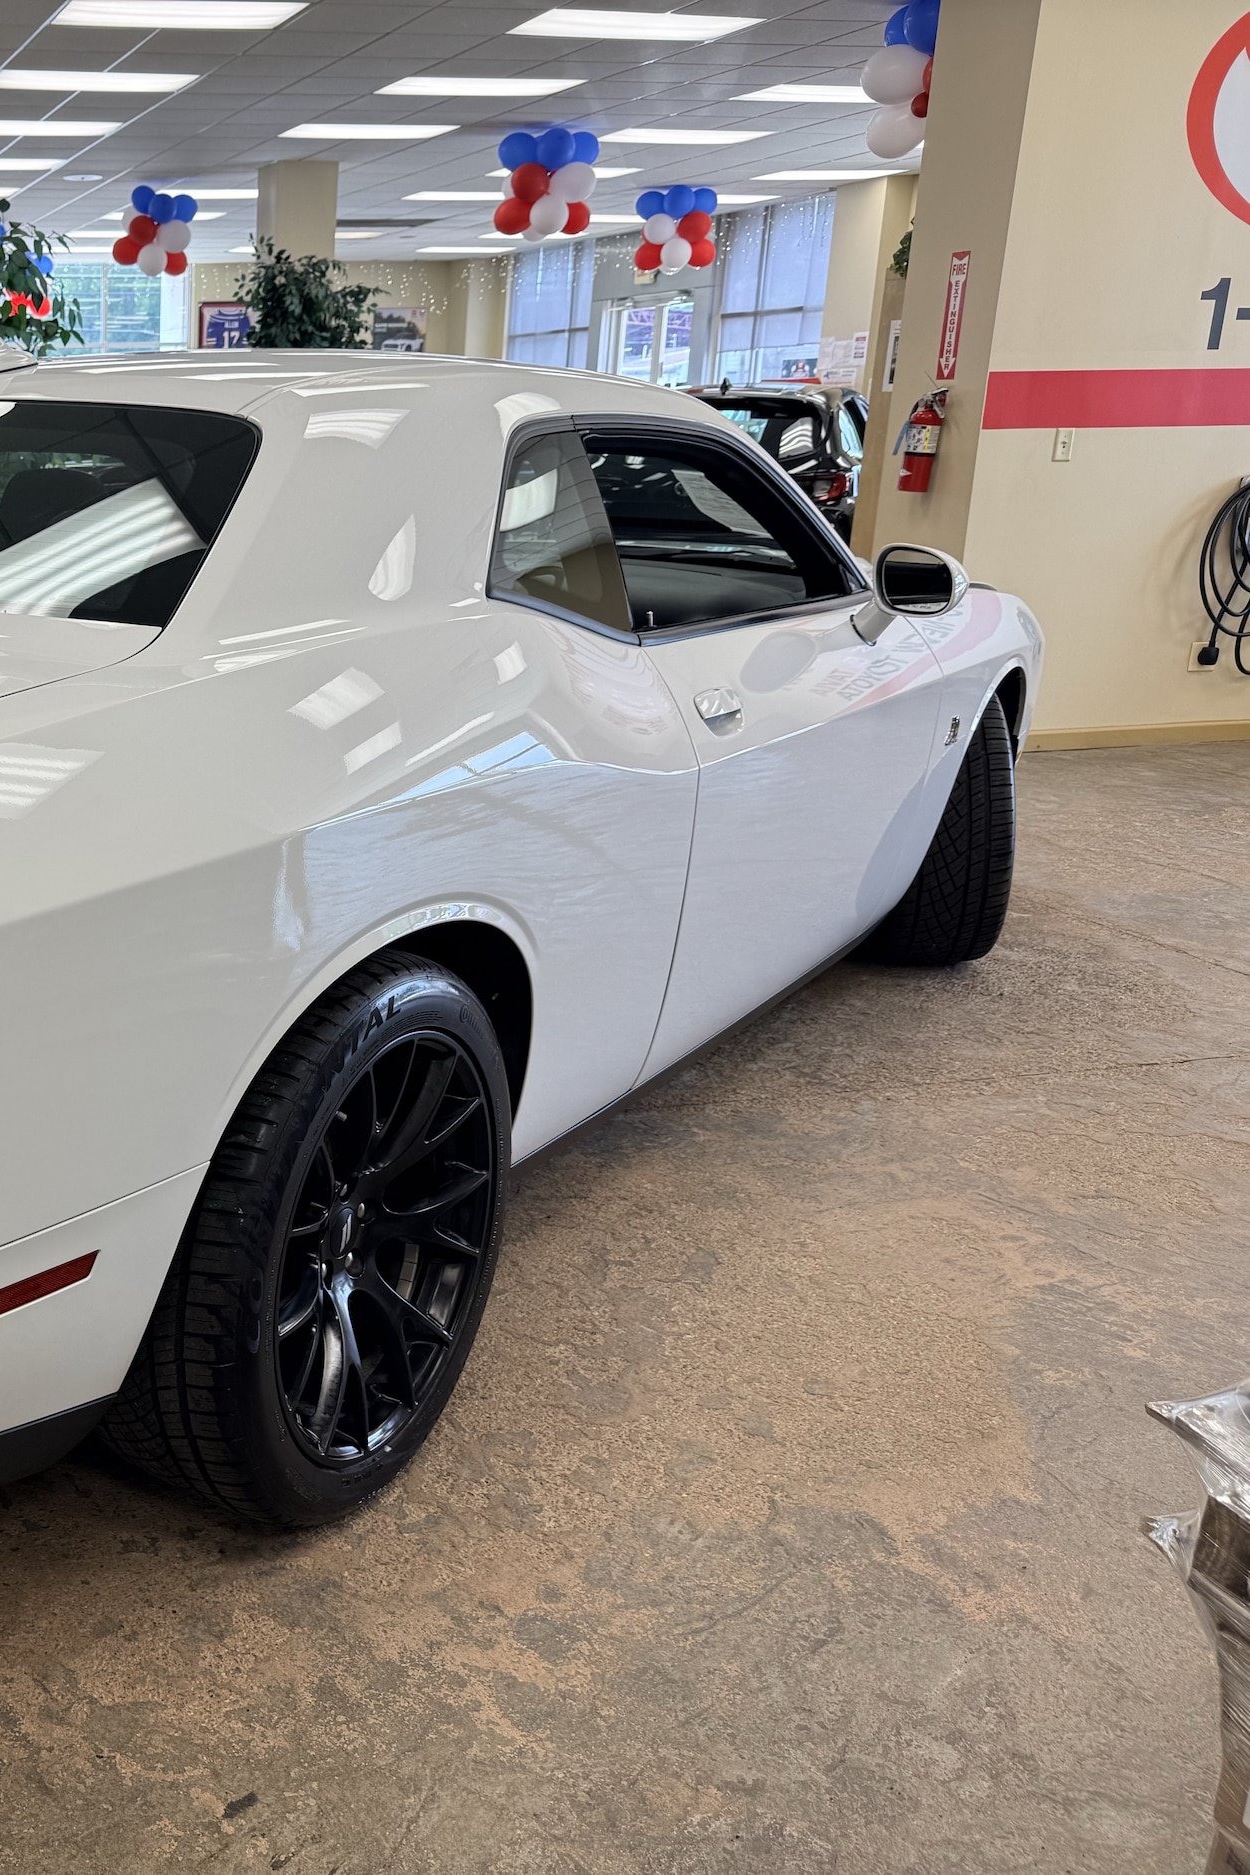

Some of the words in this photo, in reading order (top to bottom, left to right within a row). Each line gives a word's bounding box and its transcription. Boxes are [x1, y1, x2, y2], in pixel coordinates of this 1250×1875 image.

[952, 263, 967, 276] FIRE
[943, 280, 961, 370] EXTINGUISHER
[222, 330, 240, 349] 17
